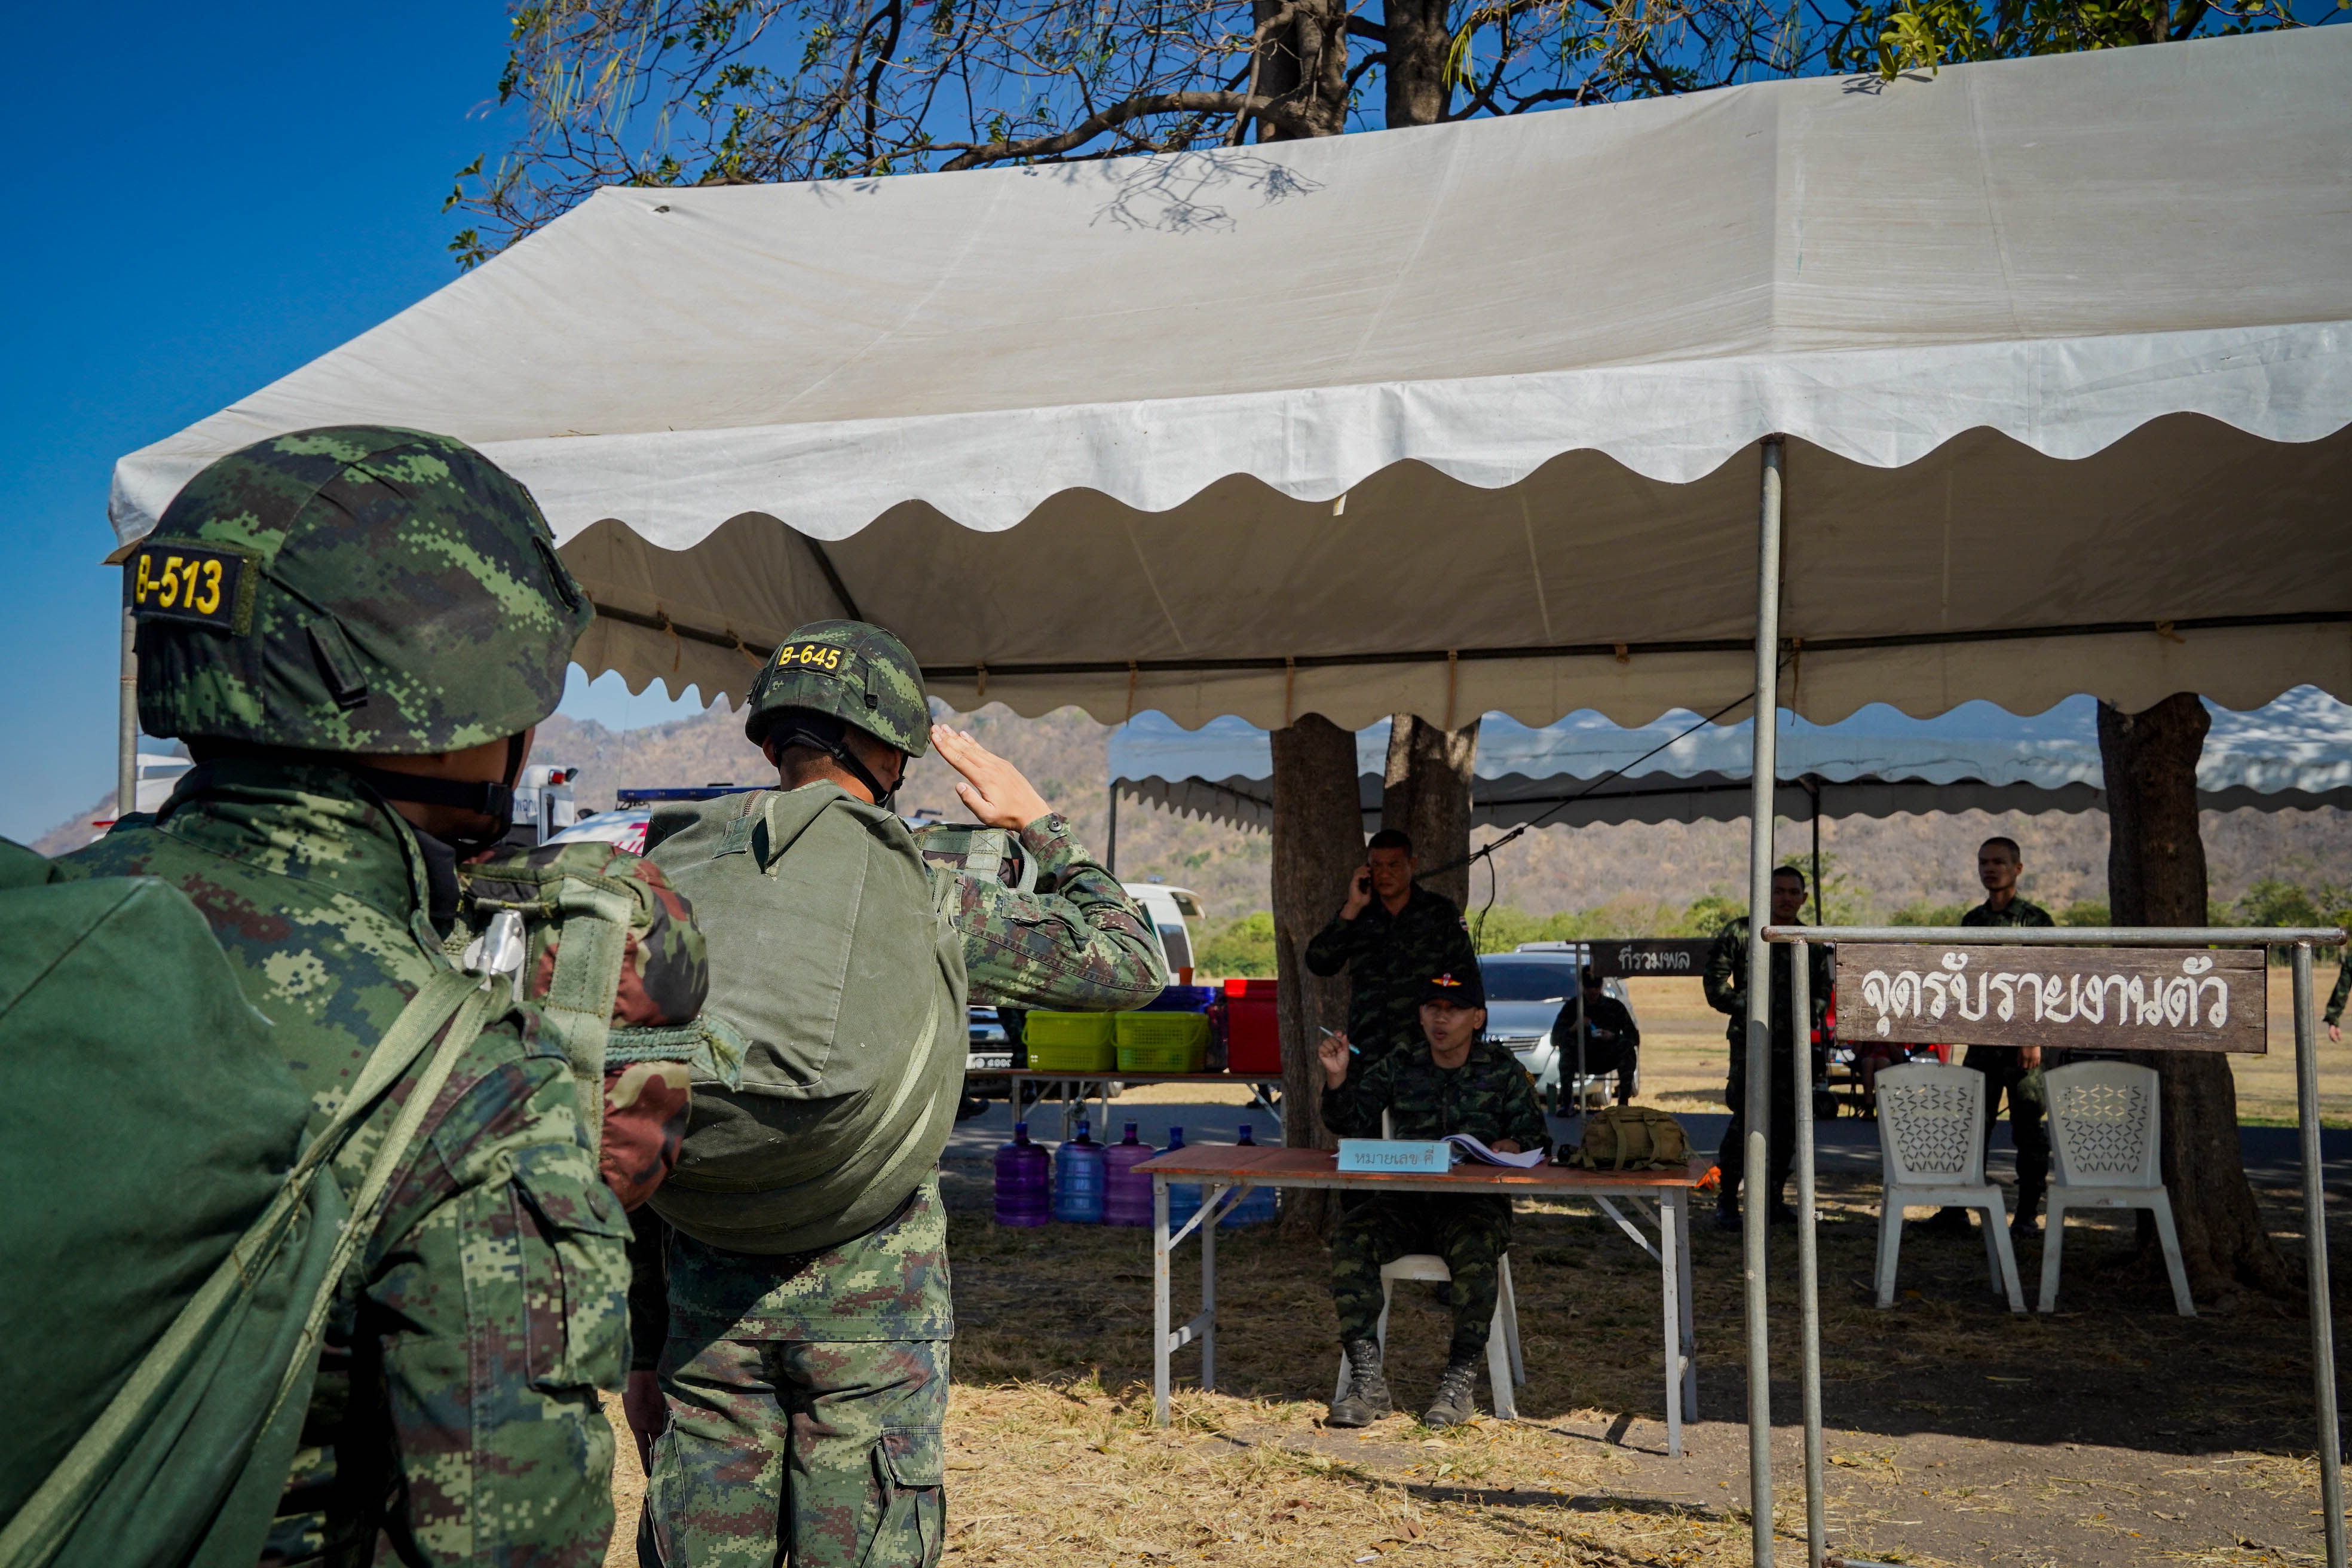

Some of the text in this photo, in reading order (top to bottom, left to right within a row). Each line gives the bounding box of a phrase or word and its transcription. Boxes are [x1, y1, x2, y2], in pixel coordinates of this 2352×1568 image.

[136, 554, 222, 614] B-513
[779, 644, 841, 669] B-645
[1618, 944, 1690, 970] ที่รวมพล
[1861, 952, 2228, 1037] จุดรับรายงานตัว
[1355, 1152, 1418, 1165] หมายเลข
